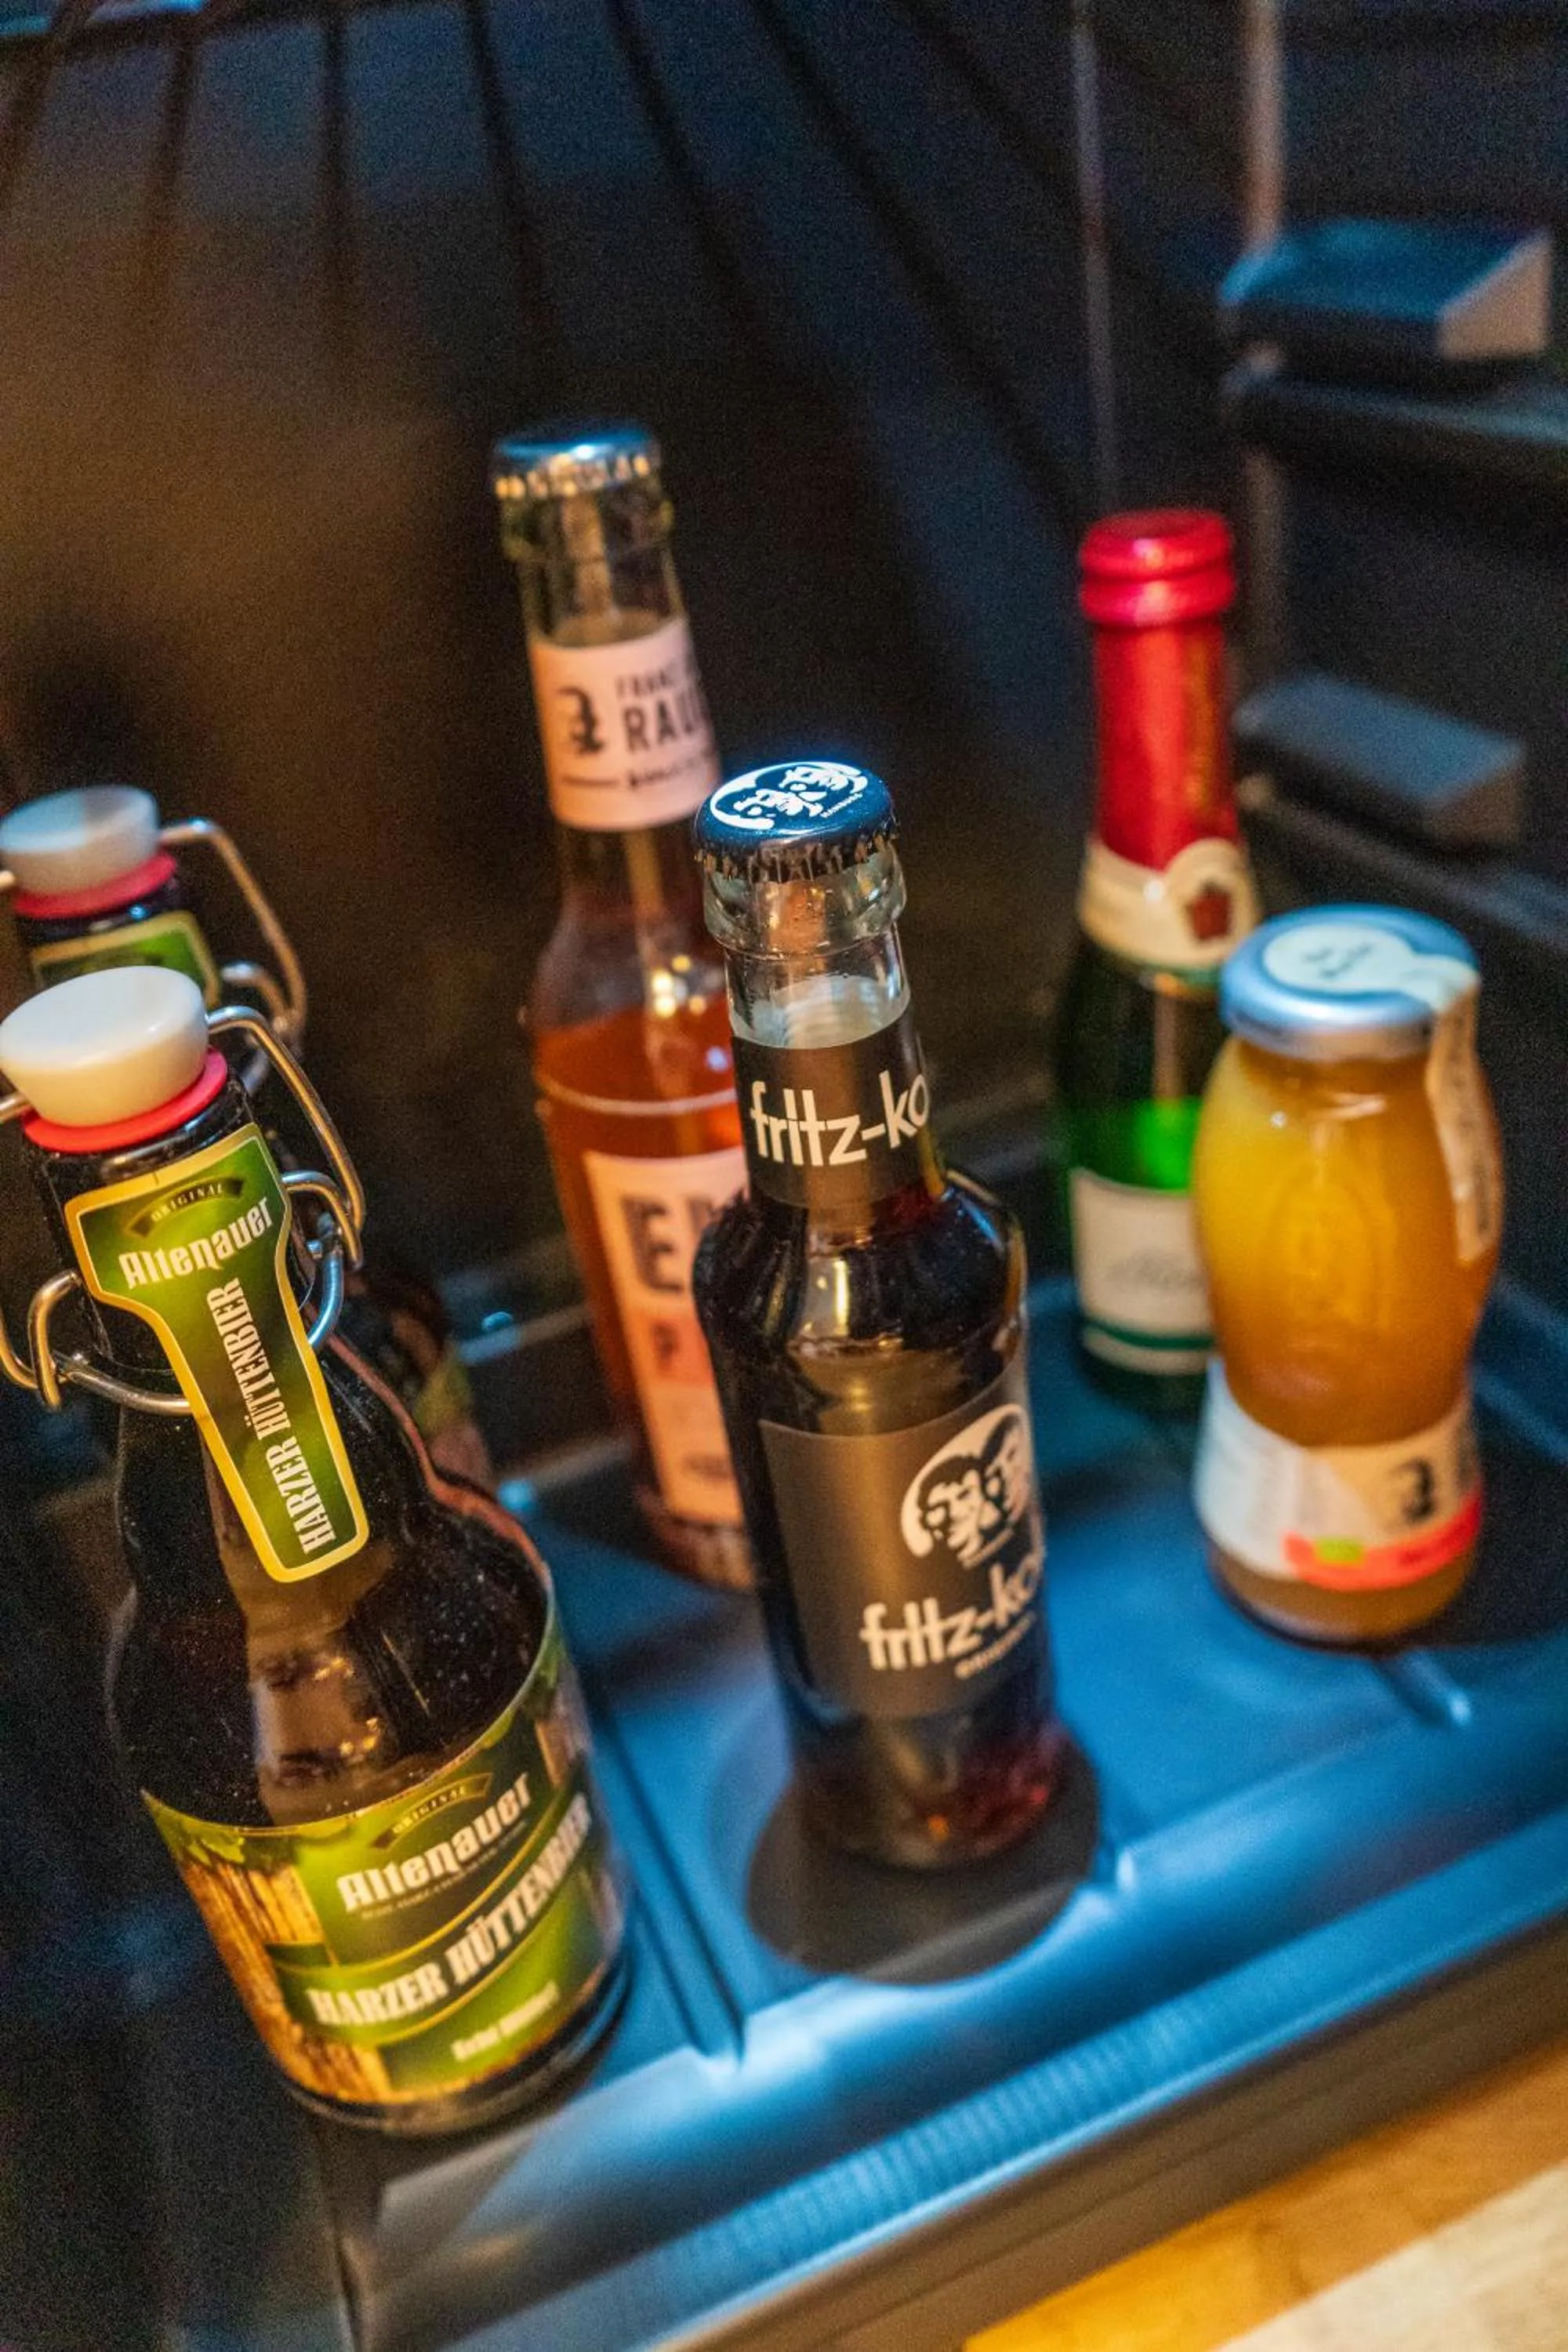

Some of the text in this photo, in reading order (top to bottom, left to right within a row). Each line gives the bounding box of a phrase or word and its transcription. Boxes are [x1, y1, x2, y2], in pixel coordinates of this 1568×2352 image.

[118, 1196, 272, 1290] Altenauer
[151, 1182, 223, 1222] ORIGINAL
[206, 1277, 336, 1555] HARZER HÜTTENBIER
[336, 1772, 532, 1914] Altenauer
[306, 1960, 448, 2026] HARZER
